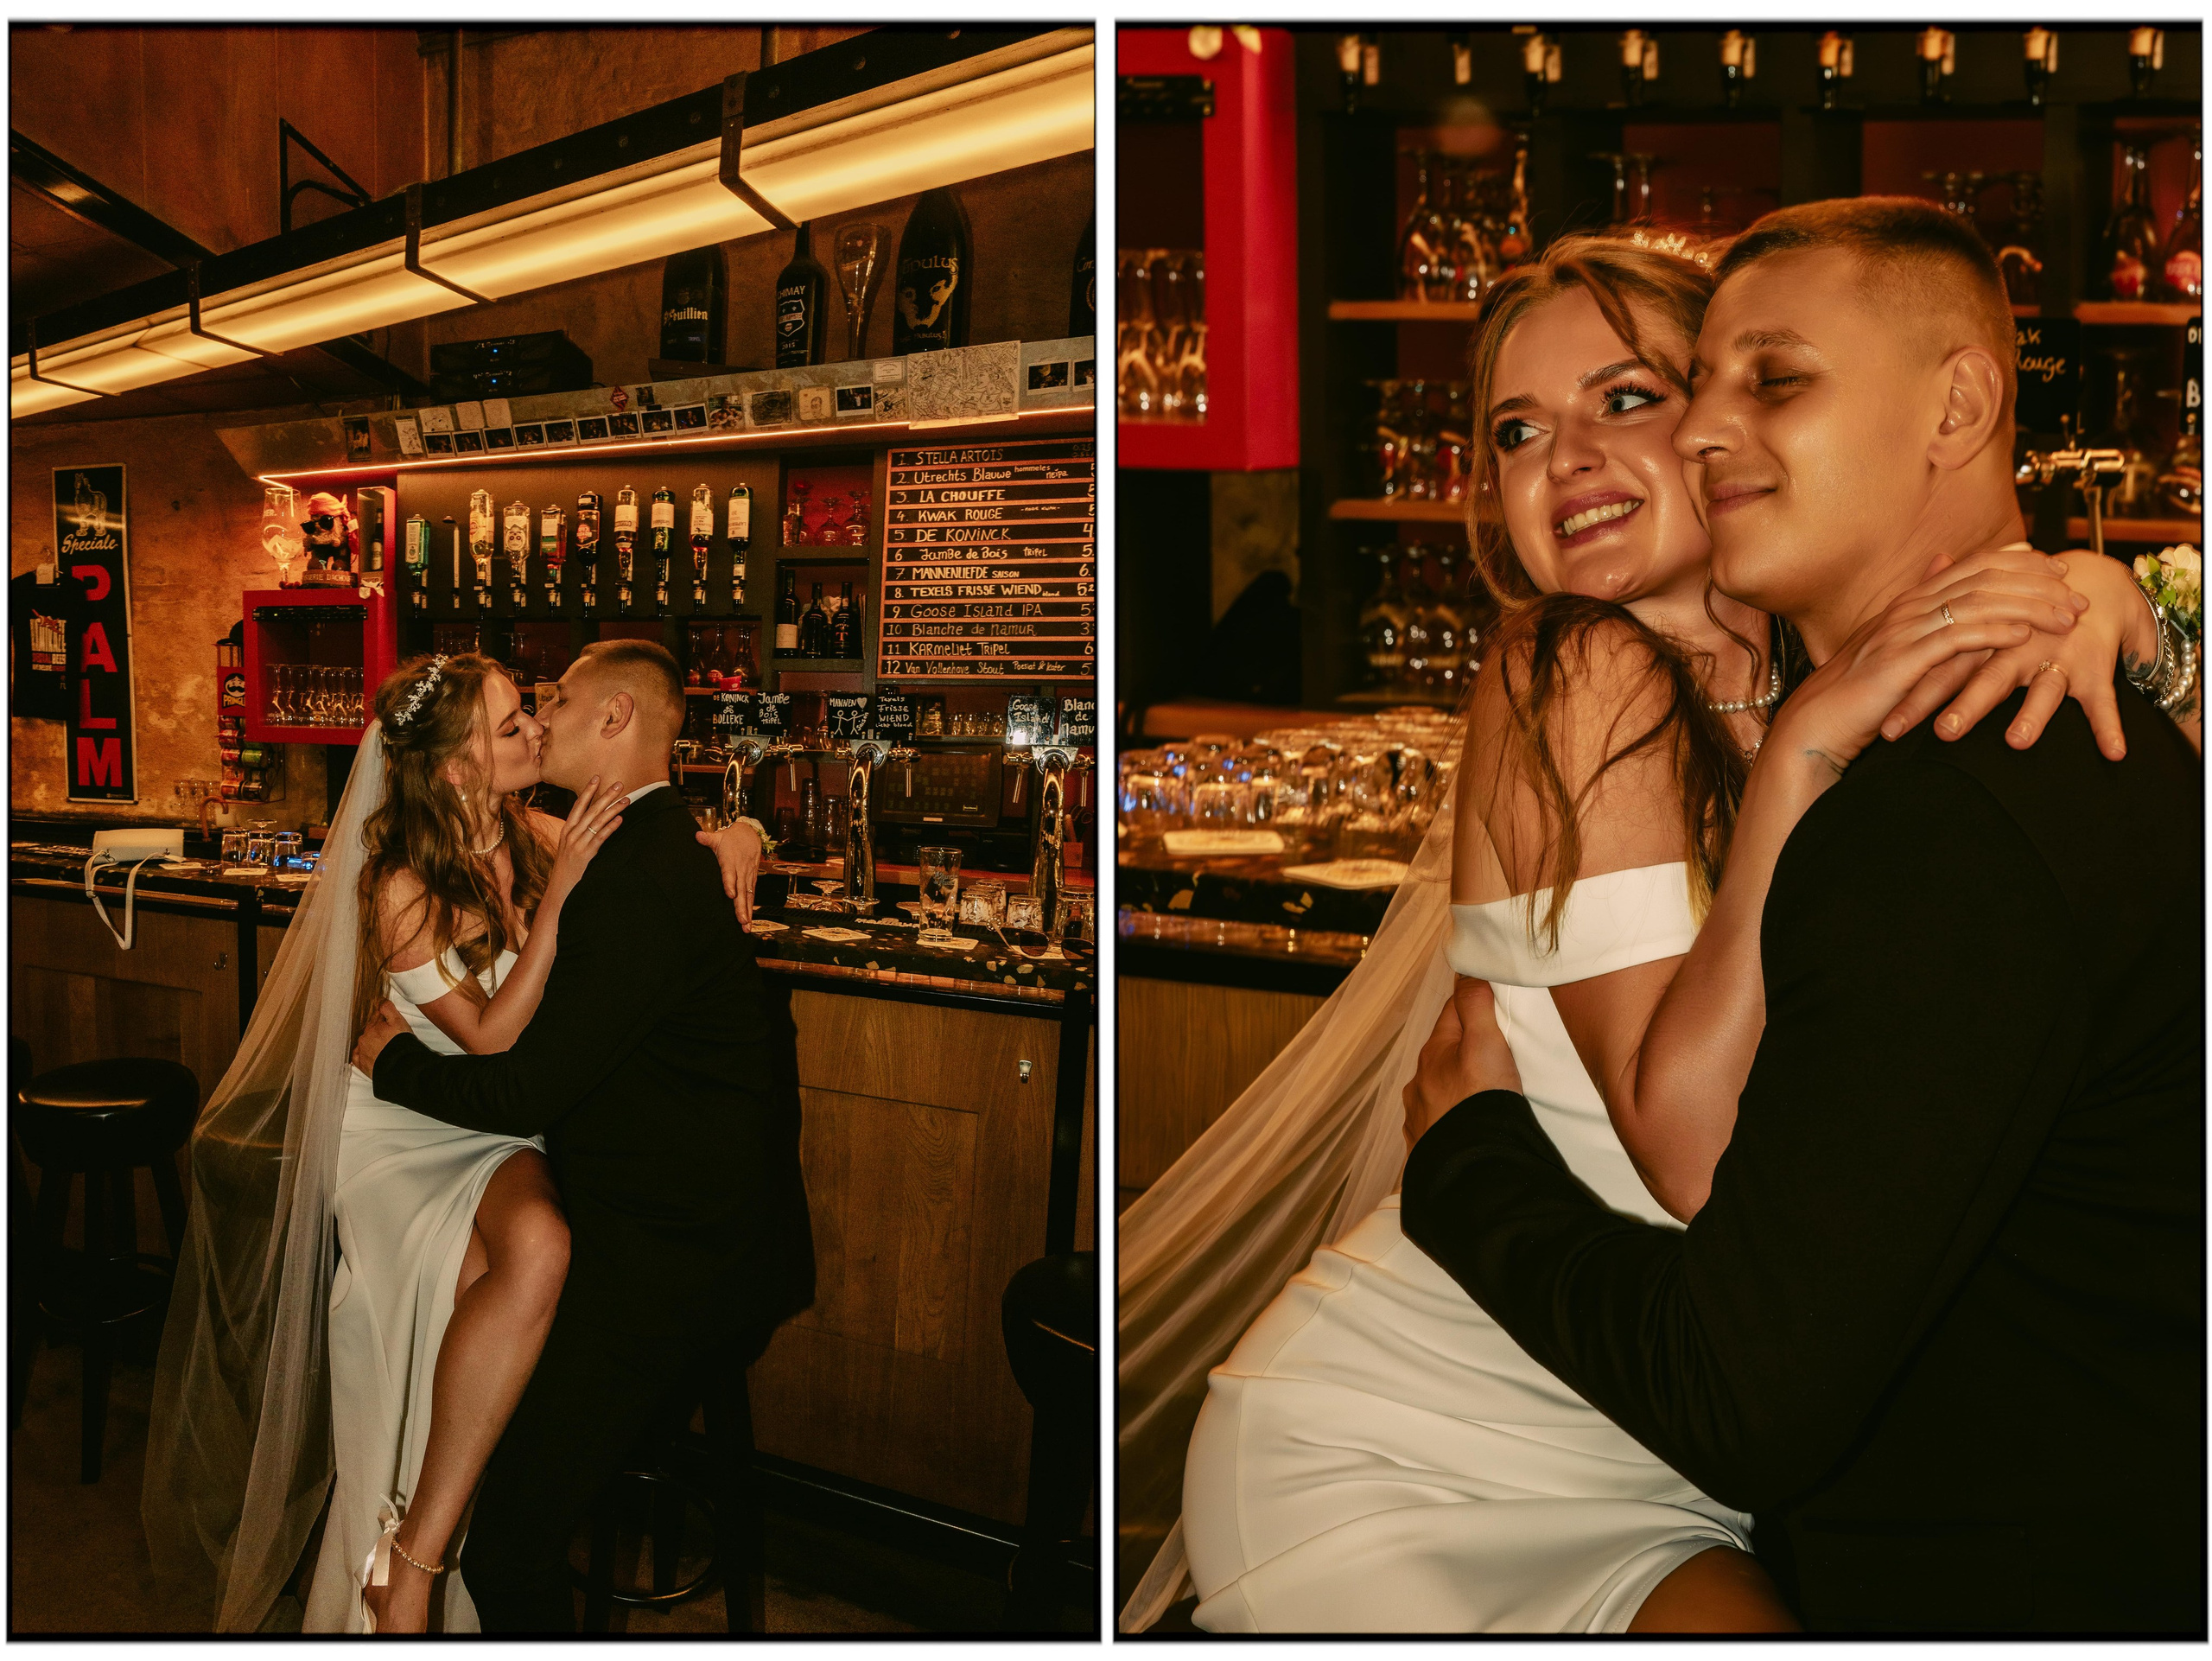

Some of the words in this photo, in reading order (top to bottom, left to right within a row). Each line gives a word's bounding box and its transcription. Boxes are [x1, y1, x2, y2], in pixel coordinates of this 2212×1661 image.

[915, 451, 957, 465] STELLA
[960, 449, 1002, 462] ARTOIS
[914, 469, 966, 484] Utrechts
[972, 468, 1011, 481] Blauwe
[919, 490, 935, 503] LA
[941, 489, 1005, 502] CHOUFFE
[918, 510, 957, 522] KWAK
[965, 507, 1003, 520] ROUGE
[915, 529, 938, 542] DE
[61, 535, 118, 555] Speciale
[894, 549, 903, 561] 6
[966, 547, 979, 559] de
[981, 546, 1007, 559] Bois
[912, 567, 988, 580] MANNENLIEFDE
[910, 586, 953, 597] TEXELS
[957, 585, 995, 596] FRISSE
[1001, 584, 1042, 596] WIEND
[910, 604, 956, 618] Goose
[963, 604, 1013, 618] Island
[1022, 604, 1043, 616] IPA
[912, 623, 963, 636] Blanche
[971, 624, 985, 635] de
[905, 662, 920, 673] Van
[925, 661, 969, 674] Vollenhove
[977, 661, 1004, 674] Stout
[71, 564, 123, 787] PALM
[766, 703, 777, 712] de
[830, 697, 857, 708] MANNEN
[1013, 698, 1038, 710] Goose
[713, 714, 745, 724] BOLLEKE
[759, 709, 779, 719] Bois
[879, 714, 910, 722] WIEND
[1014, 712, 1048, 724] Island
[1075, 711, 1089, 722] de
